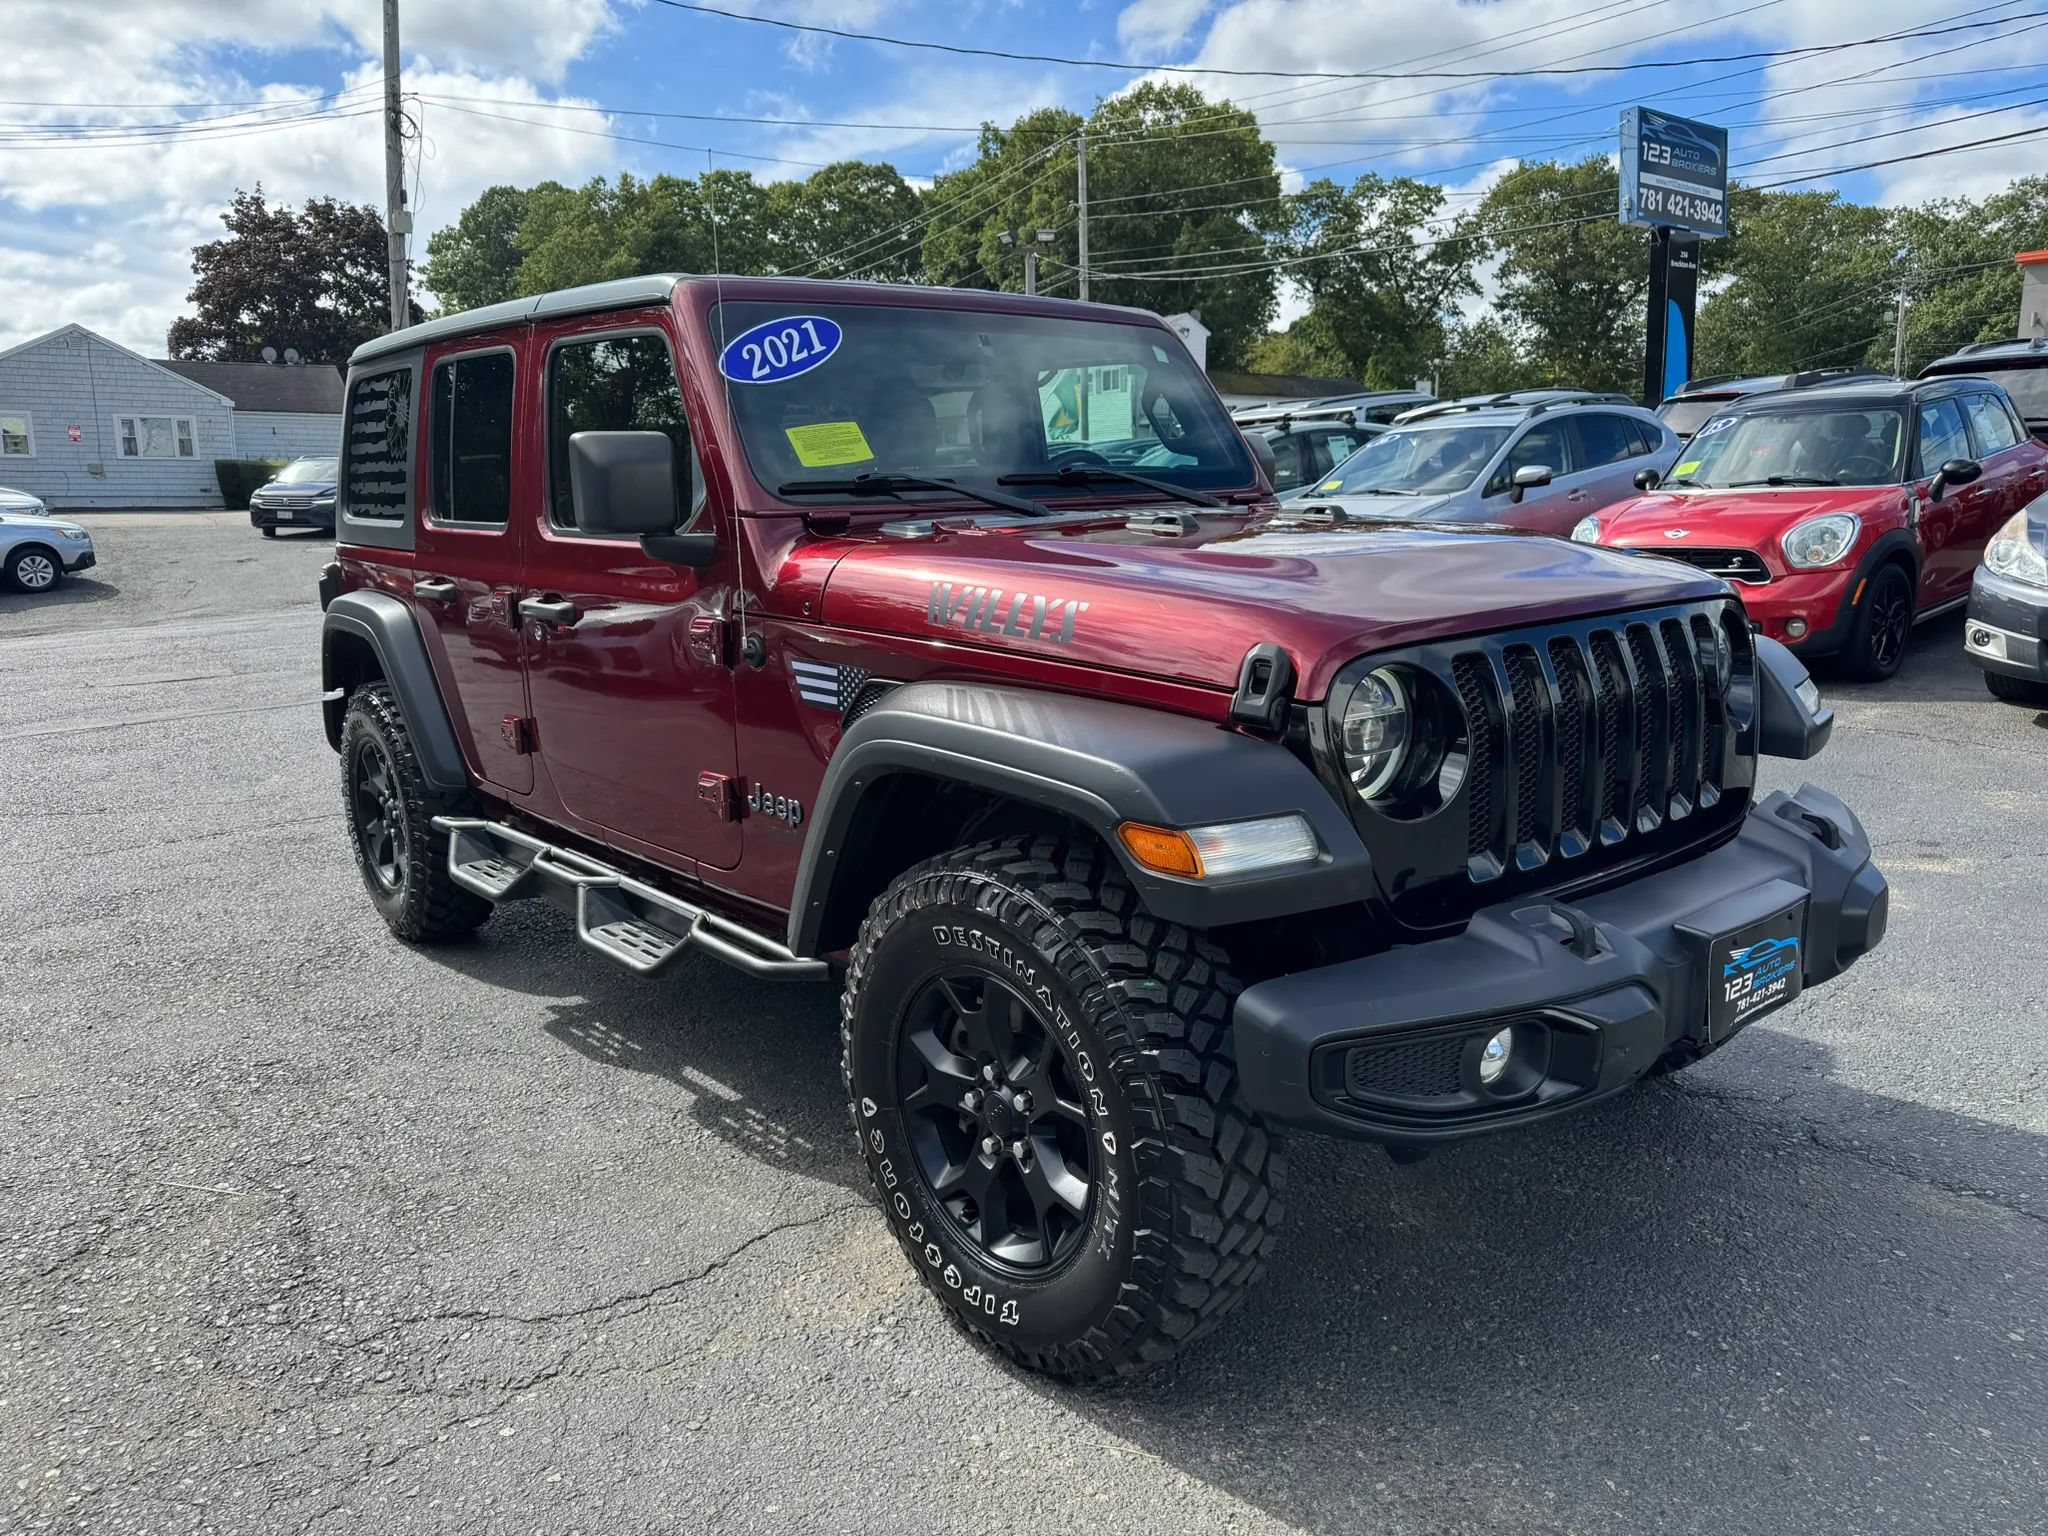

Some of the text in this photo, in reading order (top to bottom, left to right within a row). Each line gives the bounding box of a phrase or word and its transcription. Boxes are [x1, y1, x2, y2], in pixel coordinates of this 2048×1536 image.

[1642, 141, 1671, 165] 123
[1671, 160, 1717, 176] BROKERS
[1673, 147, 1700, 160] AUTO
[1640, 188, 1723, 224] 781 421-3942
[742, 320, 827, 379] 2021
[927, 581, 1091, 644] WILLYS
[747, 782, 804, 828] Jeep
[1752, 960, 1796, 990] BROKERS
[1755, 957, 1781, 977] AUTO
[1724, 972, 1754, 1002] 123
[1736, 977, 1786, 1013] 781-421-3942
[932, 924, 1108, 1116] DESTINATION
